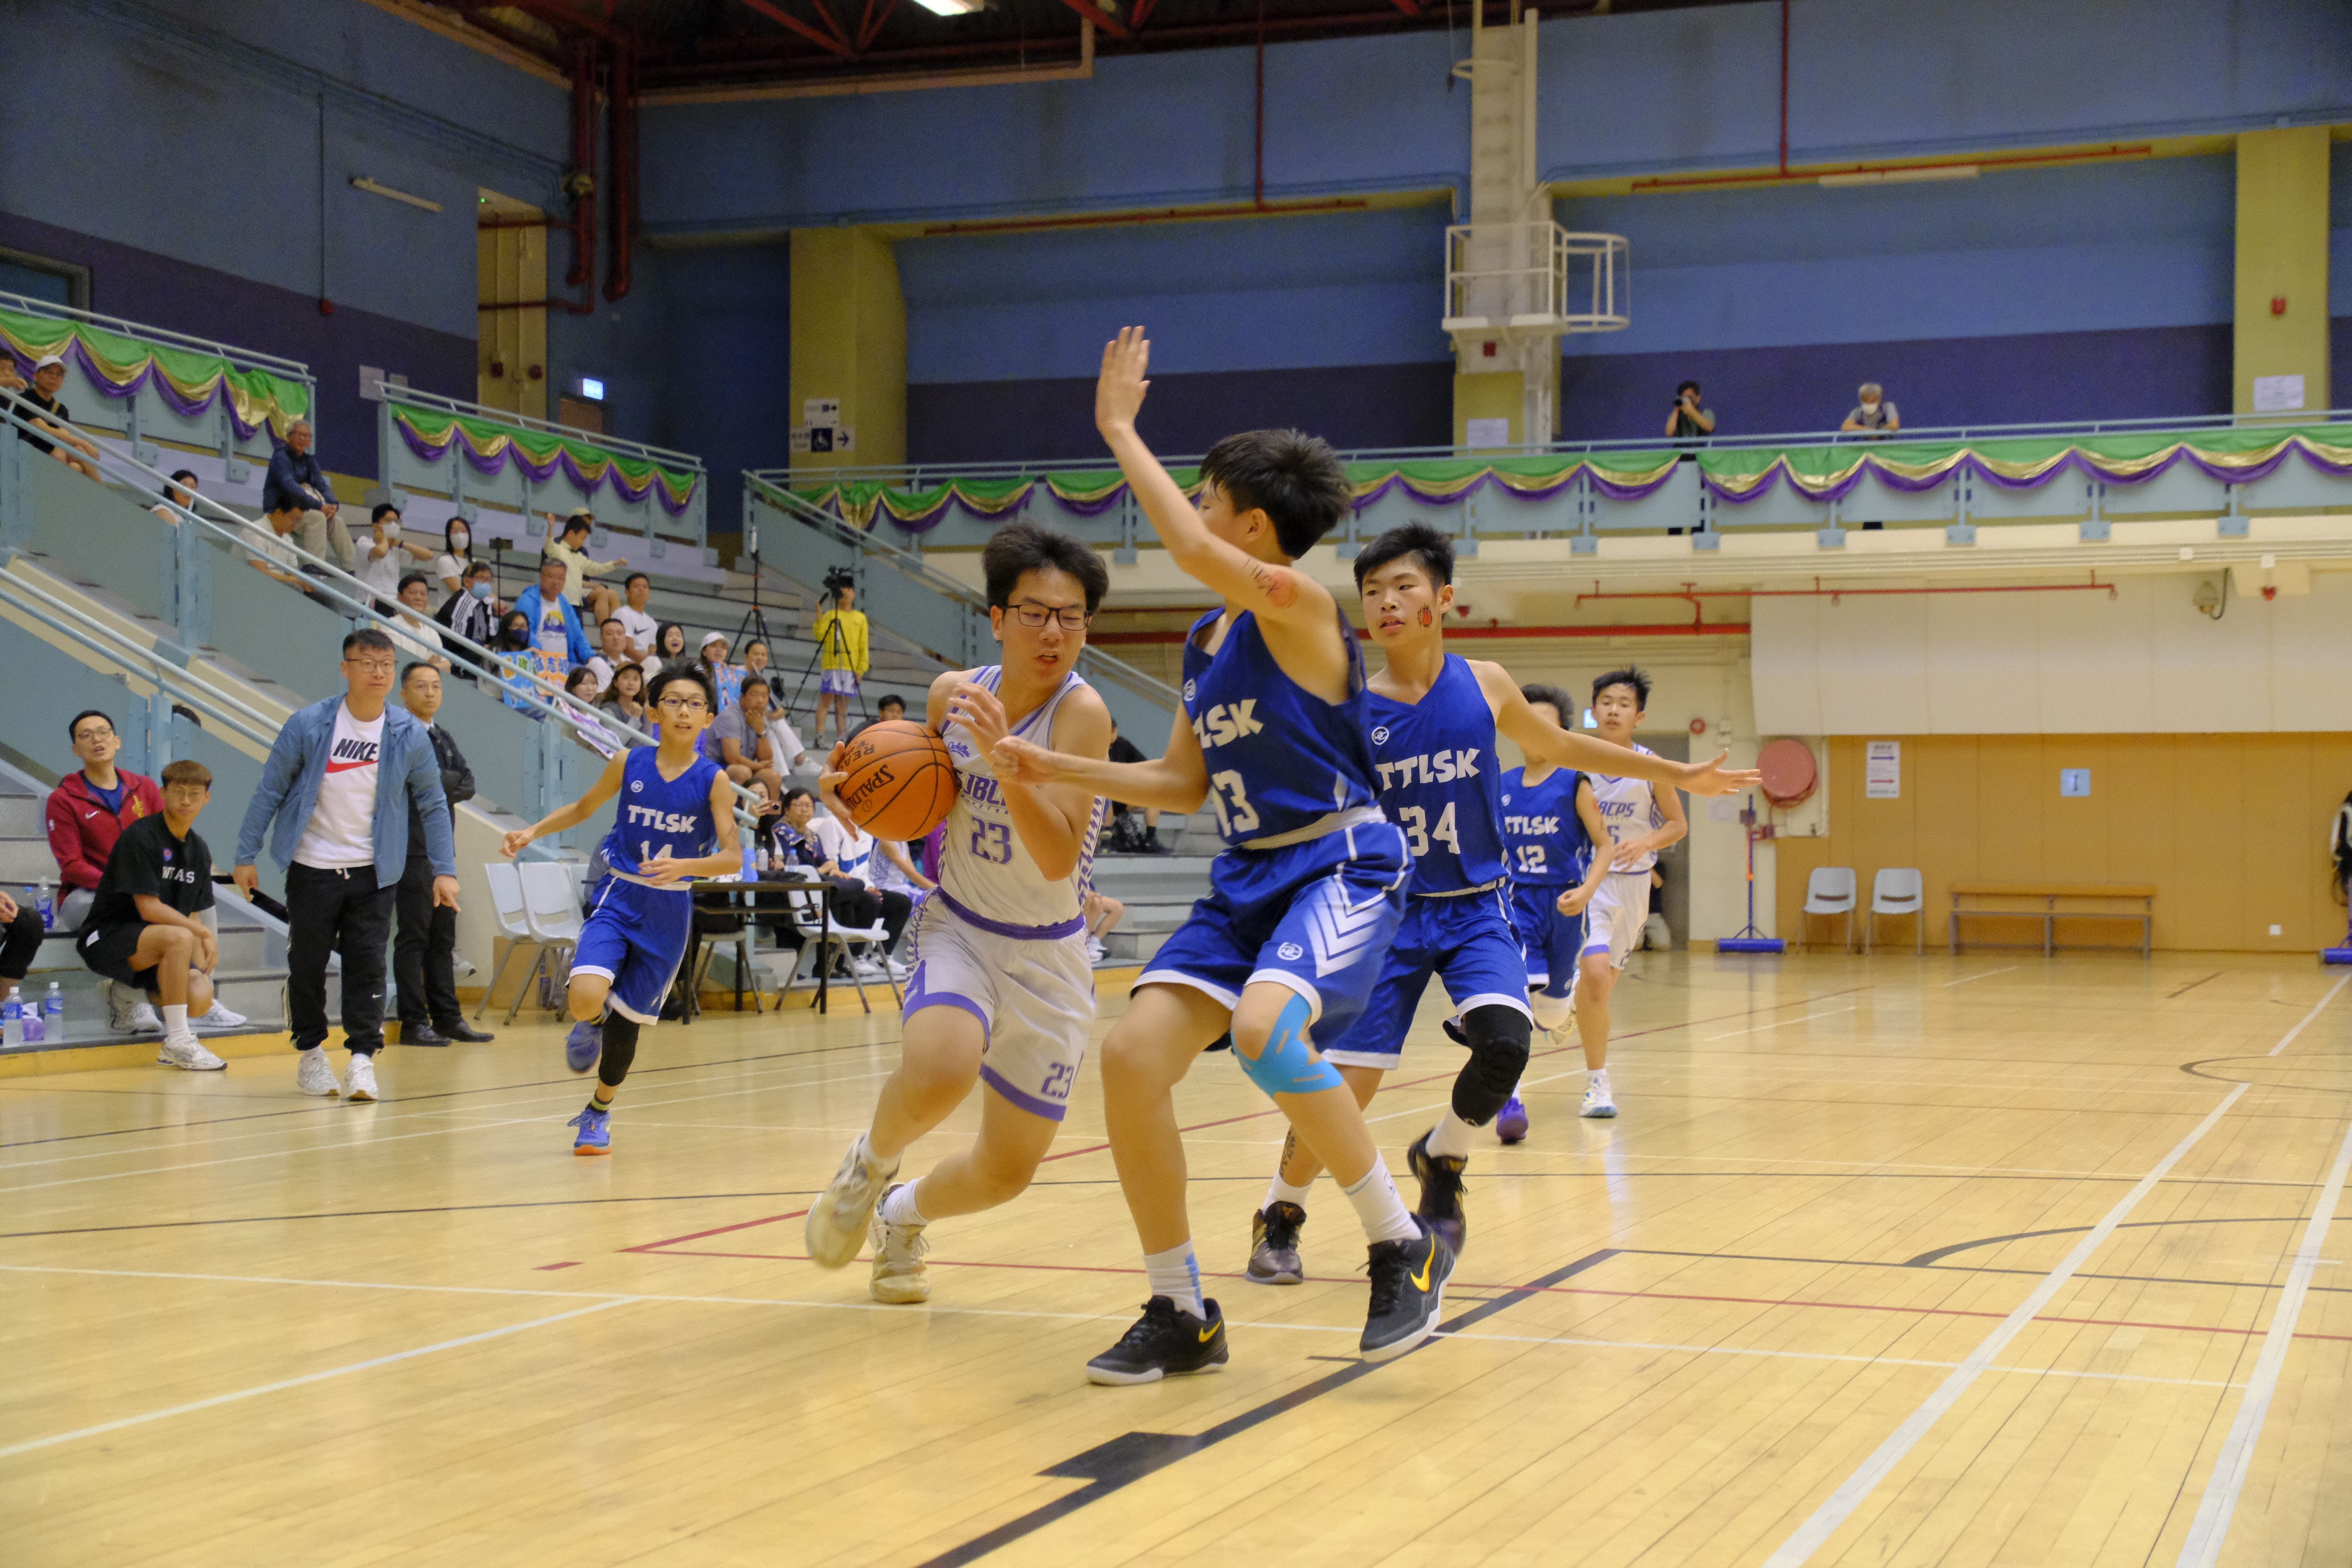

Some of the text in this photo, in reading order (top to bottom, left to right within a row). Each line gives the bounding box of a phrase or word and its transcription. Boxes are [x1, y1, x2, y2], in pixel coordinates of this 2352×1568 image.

[333, 738, 378, 762] NIKE
[1374, 748, 1480, 791] TTLSK
[627, 805, 698, 834] TTLSK
[1211, 769, 1260, 837] 13
[971, 815, 1012, 864] 23
[1399, 801, 1461, 856] 34
[1516, 845, 1548, 874] 12
[1040, 1062, 1074, 1099] 23
